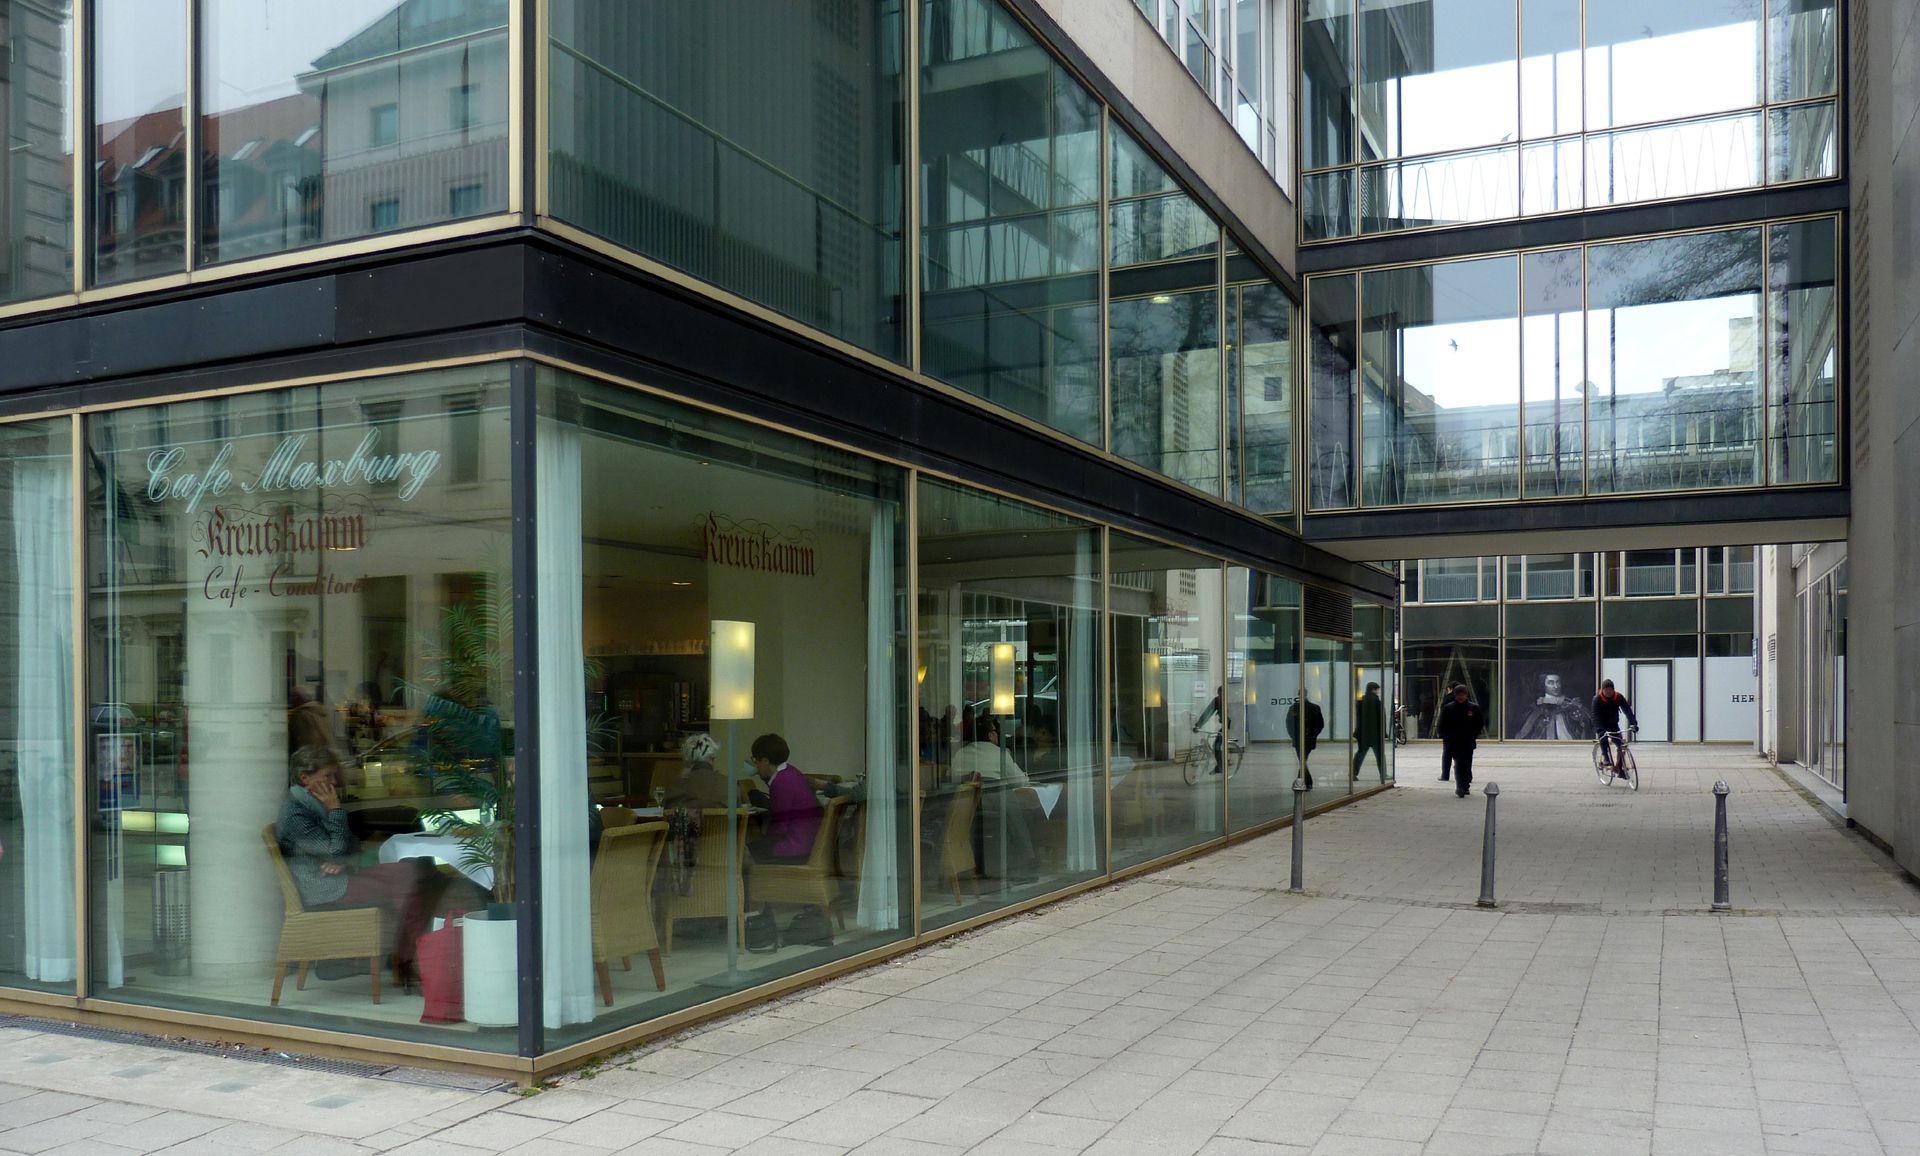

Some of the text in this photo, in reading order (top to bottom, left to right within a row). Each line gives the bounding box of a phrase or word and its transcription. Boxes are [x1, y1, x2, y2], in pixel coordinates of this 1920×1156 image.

[147, 427, 441, 513] Cafe Maxburg
[195, 503, 366, 559] Kreutzkamm
[701, 510, 815, 577] Kreutzkamm
[204, 564, 248, 608] Cafe
